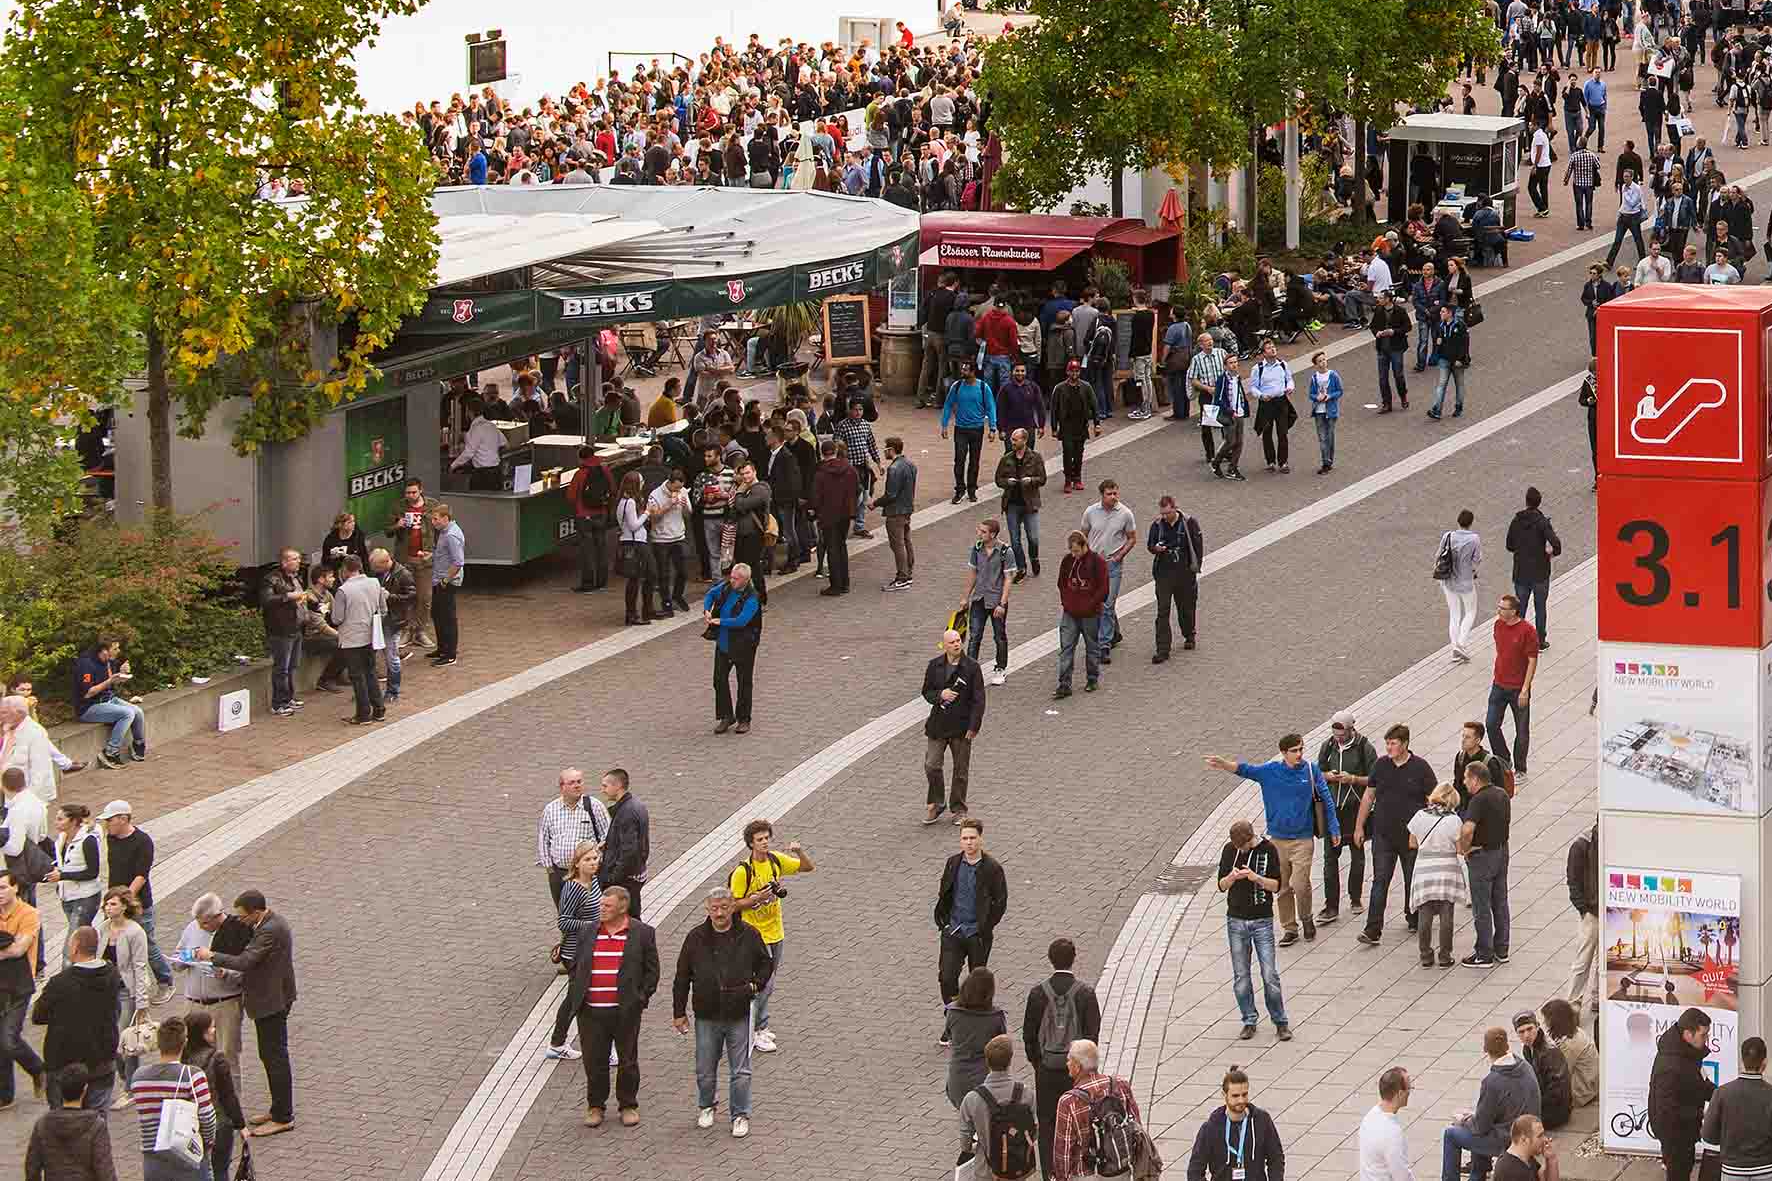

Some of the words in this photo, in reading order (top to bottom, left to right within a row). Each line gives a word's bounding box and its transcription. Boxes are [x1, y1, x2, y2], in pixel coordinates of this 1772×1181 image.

[981, 245, 1041, 260] Flammkuchen
[808, 263, 864, 289] BECK'S
[562, 293, 653, 316] BECK'S
[351, 464, 404, 495] BECK'S
[1614, 519, 1741, 609] 3.1
[1614, 676, 1637, 686] NEW
[1637, 677, 1681, 688] MOBILITY
[1681, 679, 1714, 690] WORLD
[1608, 890, 1638, 903] NEW
[1638, 892, 1692, 907] MOBILITY
[1695, 896, 1737, 911] WORLD
[1702, 970, 1724, 983] QUIZ
